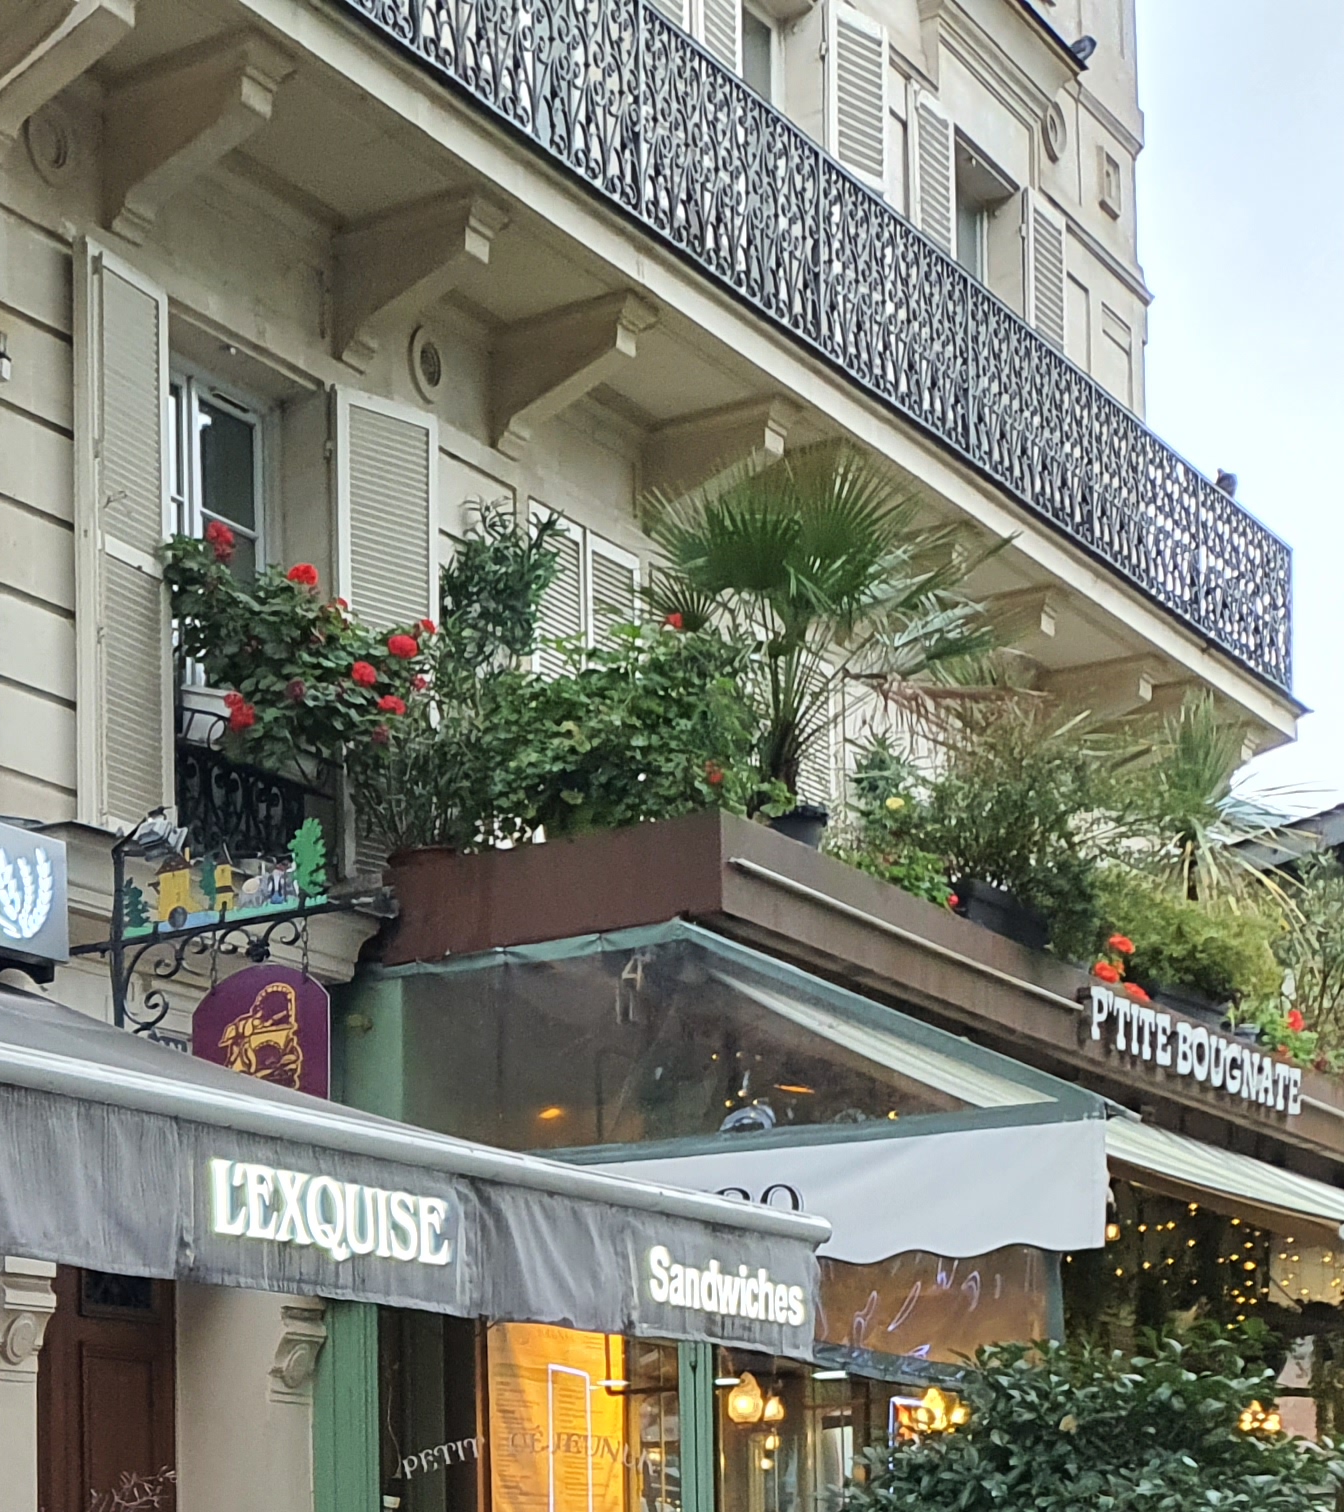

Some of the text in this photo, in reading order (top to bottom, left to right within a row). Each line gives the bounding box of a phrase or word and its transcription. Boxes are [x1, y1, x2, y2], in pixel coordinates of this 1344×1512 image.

[1090, 985, 1302, 1115] P'TITE BOUGNATE
[209, 1158, 454, 1267] L'EXQUISE
[648, 1246, 806, 1327] Sandwiches
[402, 1435, 485, 1479] PETIT
